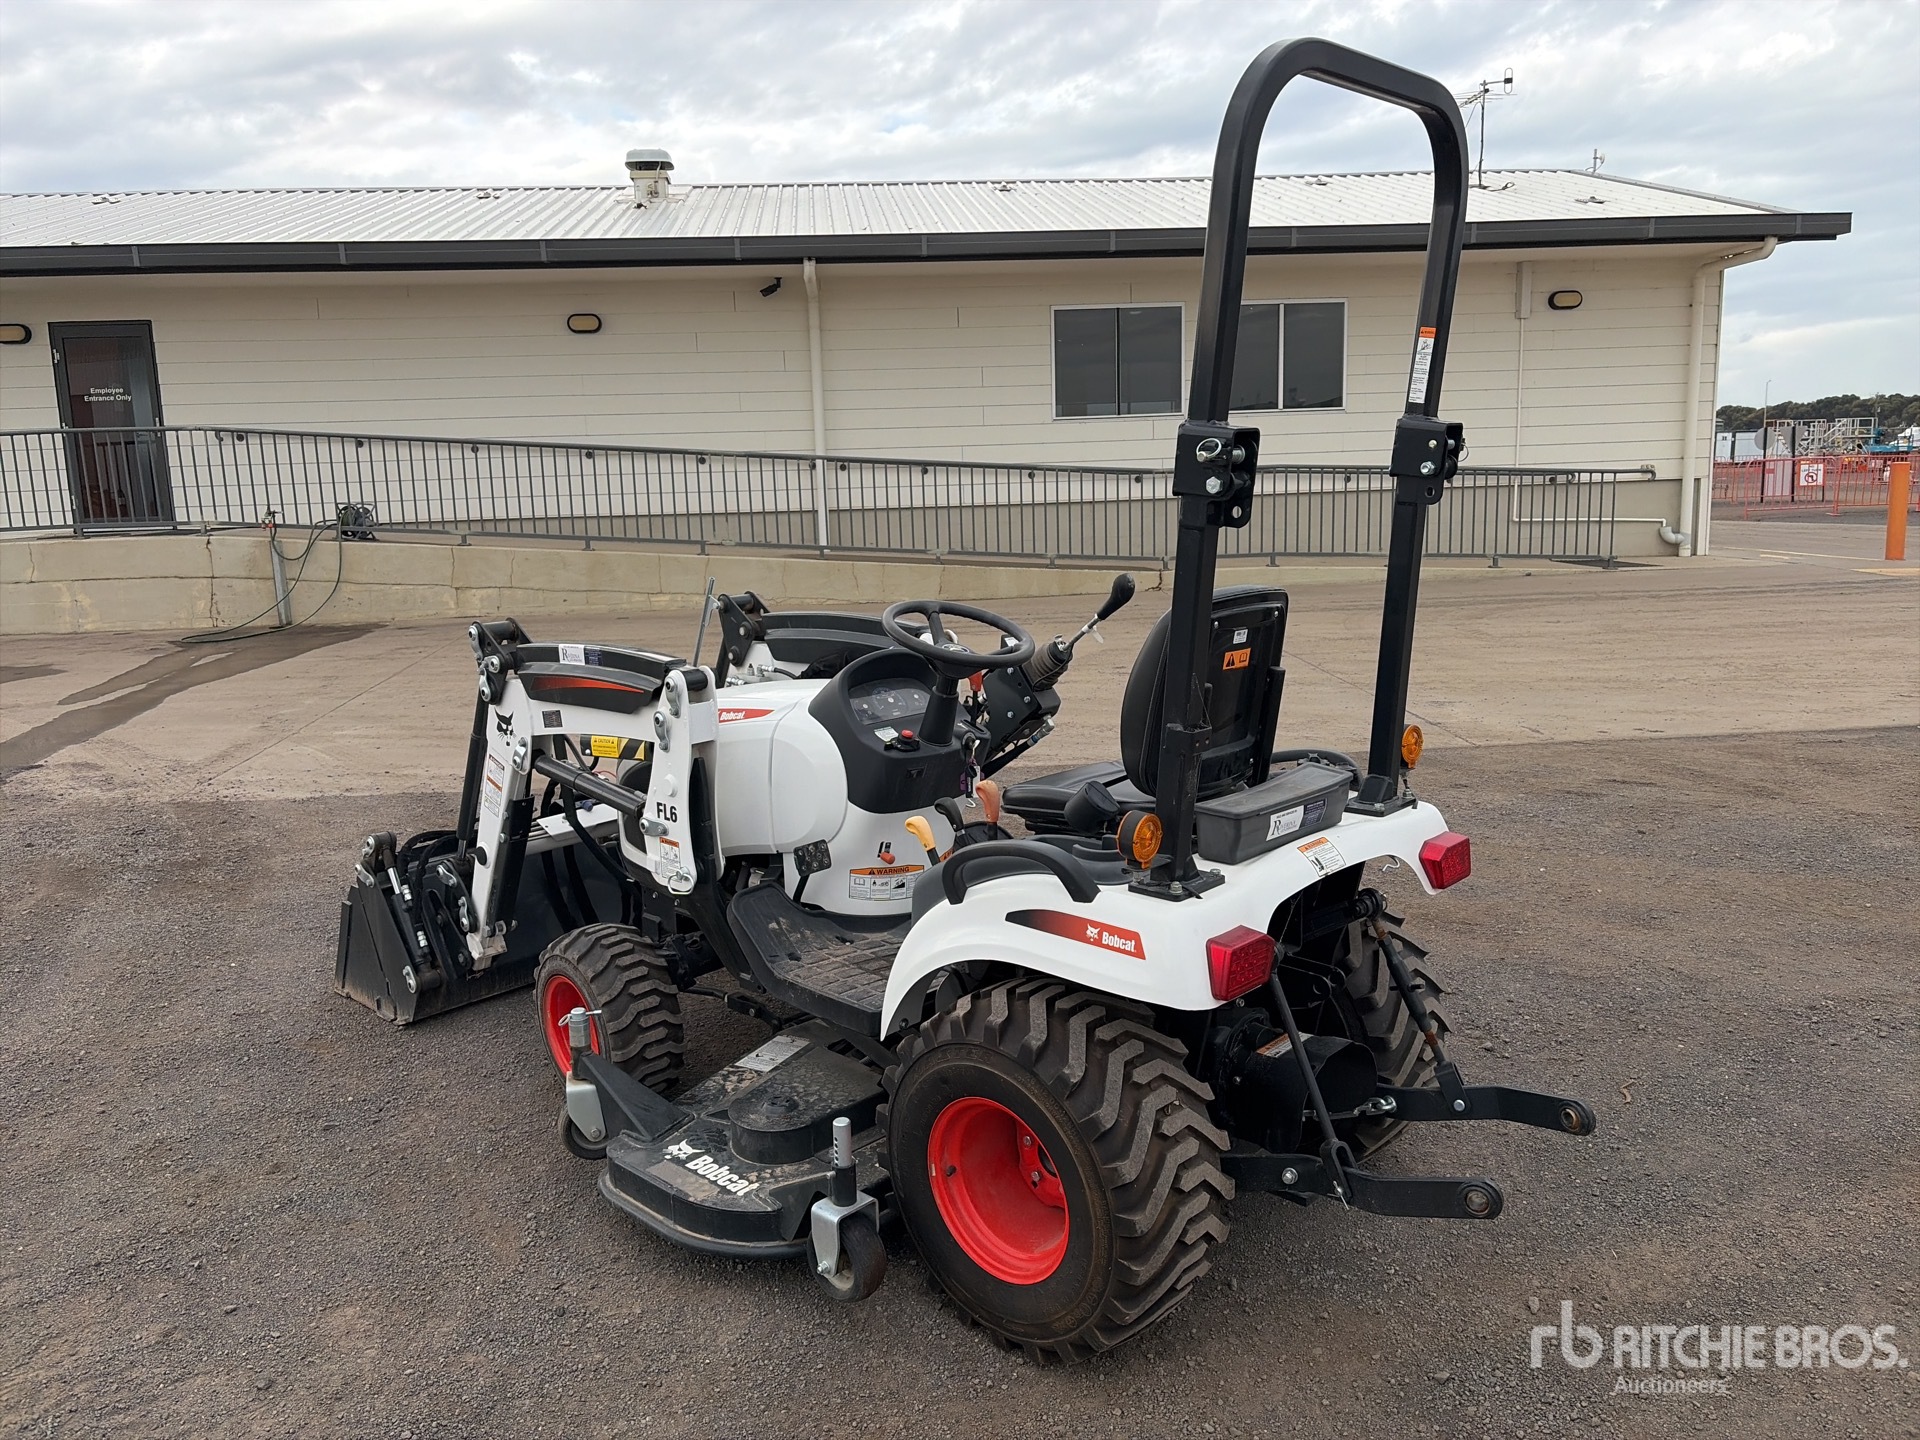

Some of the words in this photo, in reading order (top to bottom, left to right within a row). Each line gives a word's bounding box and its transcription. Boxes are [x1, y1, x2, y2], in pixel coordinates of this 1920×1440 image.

[90, 387, 124, 395] Employee
[115, 394, 132, 402] Only
[720, 710, 746, 721] Bobcat
[656, 801, 678, 823] FL6
[876, 866, 910, 875] WARNING
[1101, 931, 1136, 953] Bobcat
[684, 1154, 760, 1197] Bobcat
